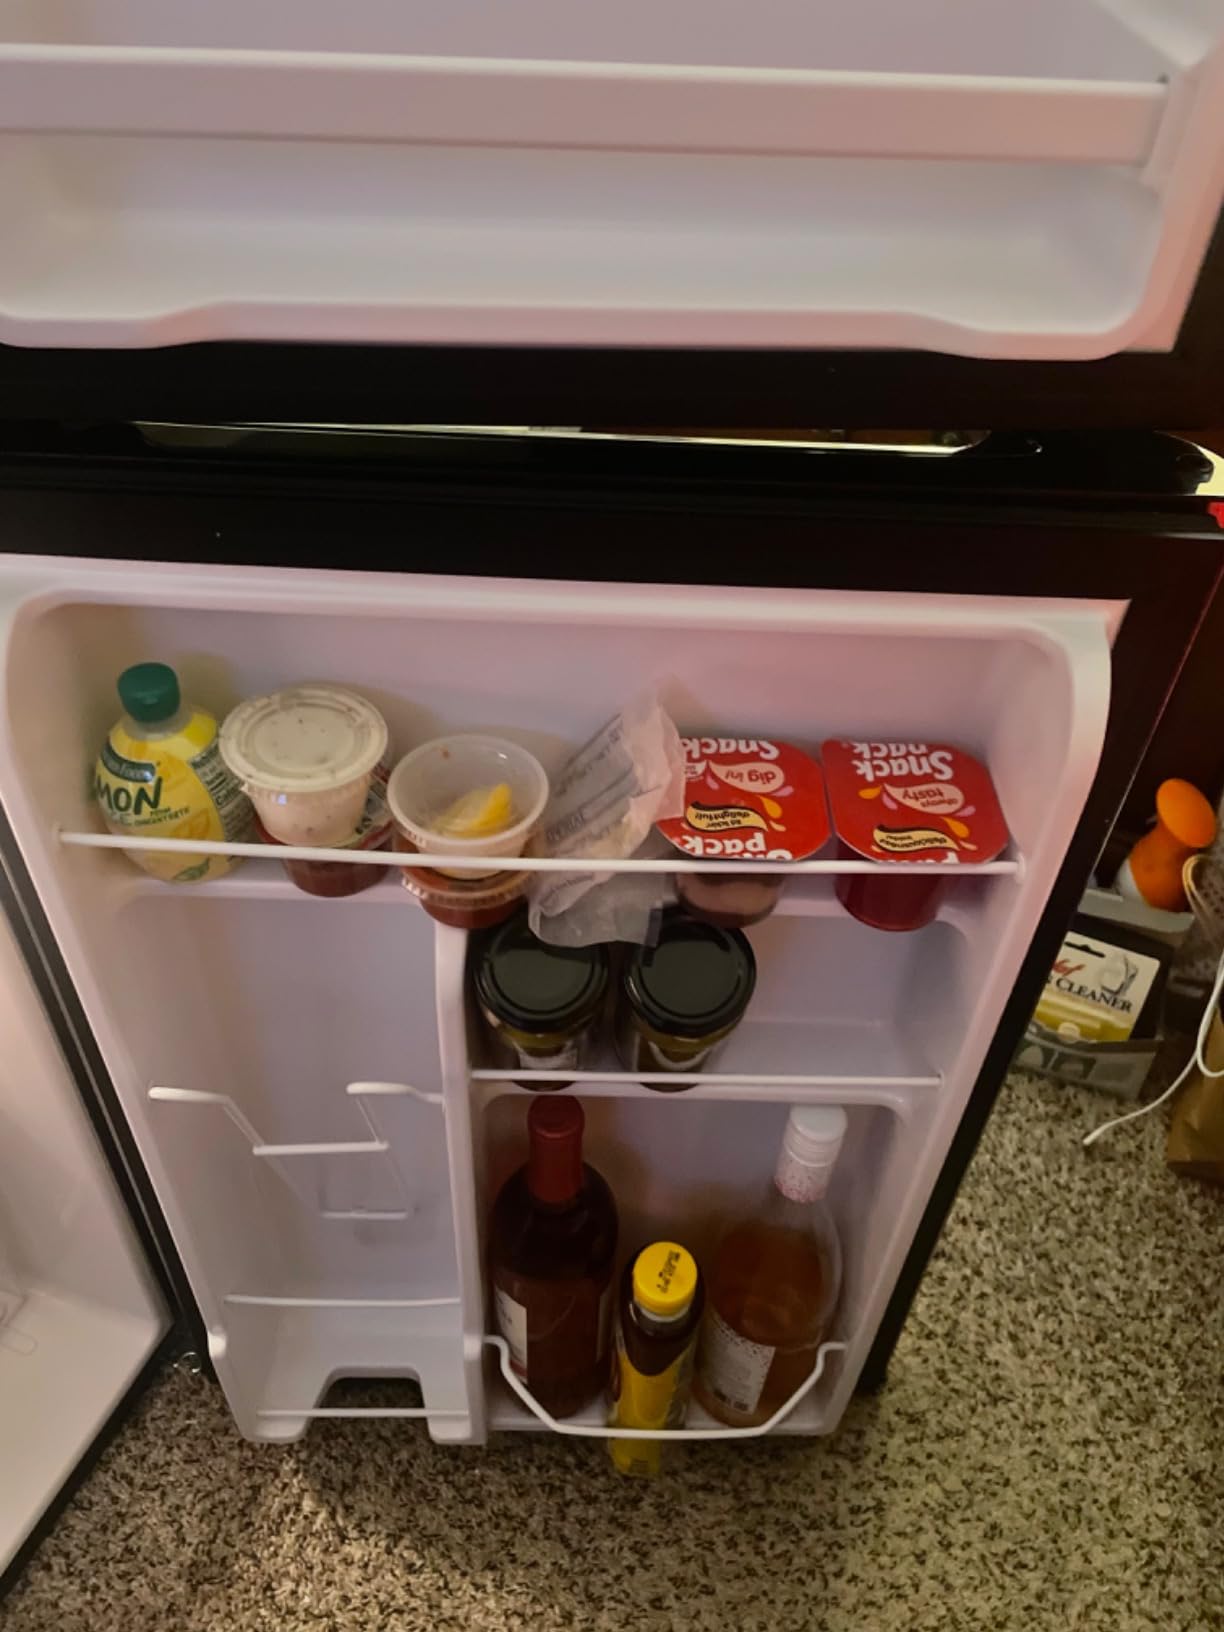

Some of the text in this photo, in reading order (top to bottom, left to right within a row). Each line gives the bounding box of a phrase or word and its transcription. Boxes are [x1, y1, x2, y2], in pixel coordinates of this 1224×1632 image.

[747, 769, 777, 785] dig
[855, 751, 953, 782] Snack
[901, 788, 944, 801] tasty
[682, 833, 766, 856] pack
[1056, 978, 1132, 1012] CLEANER
